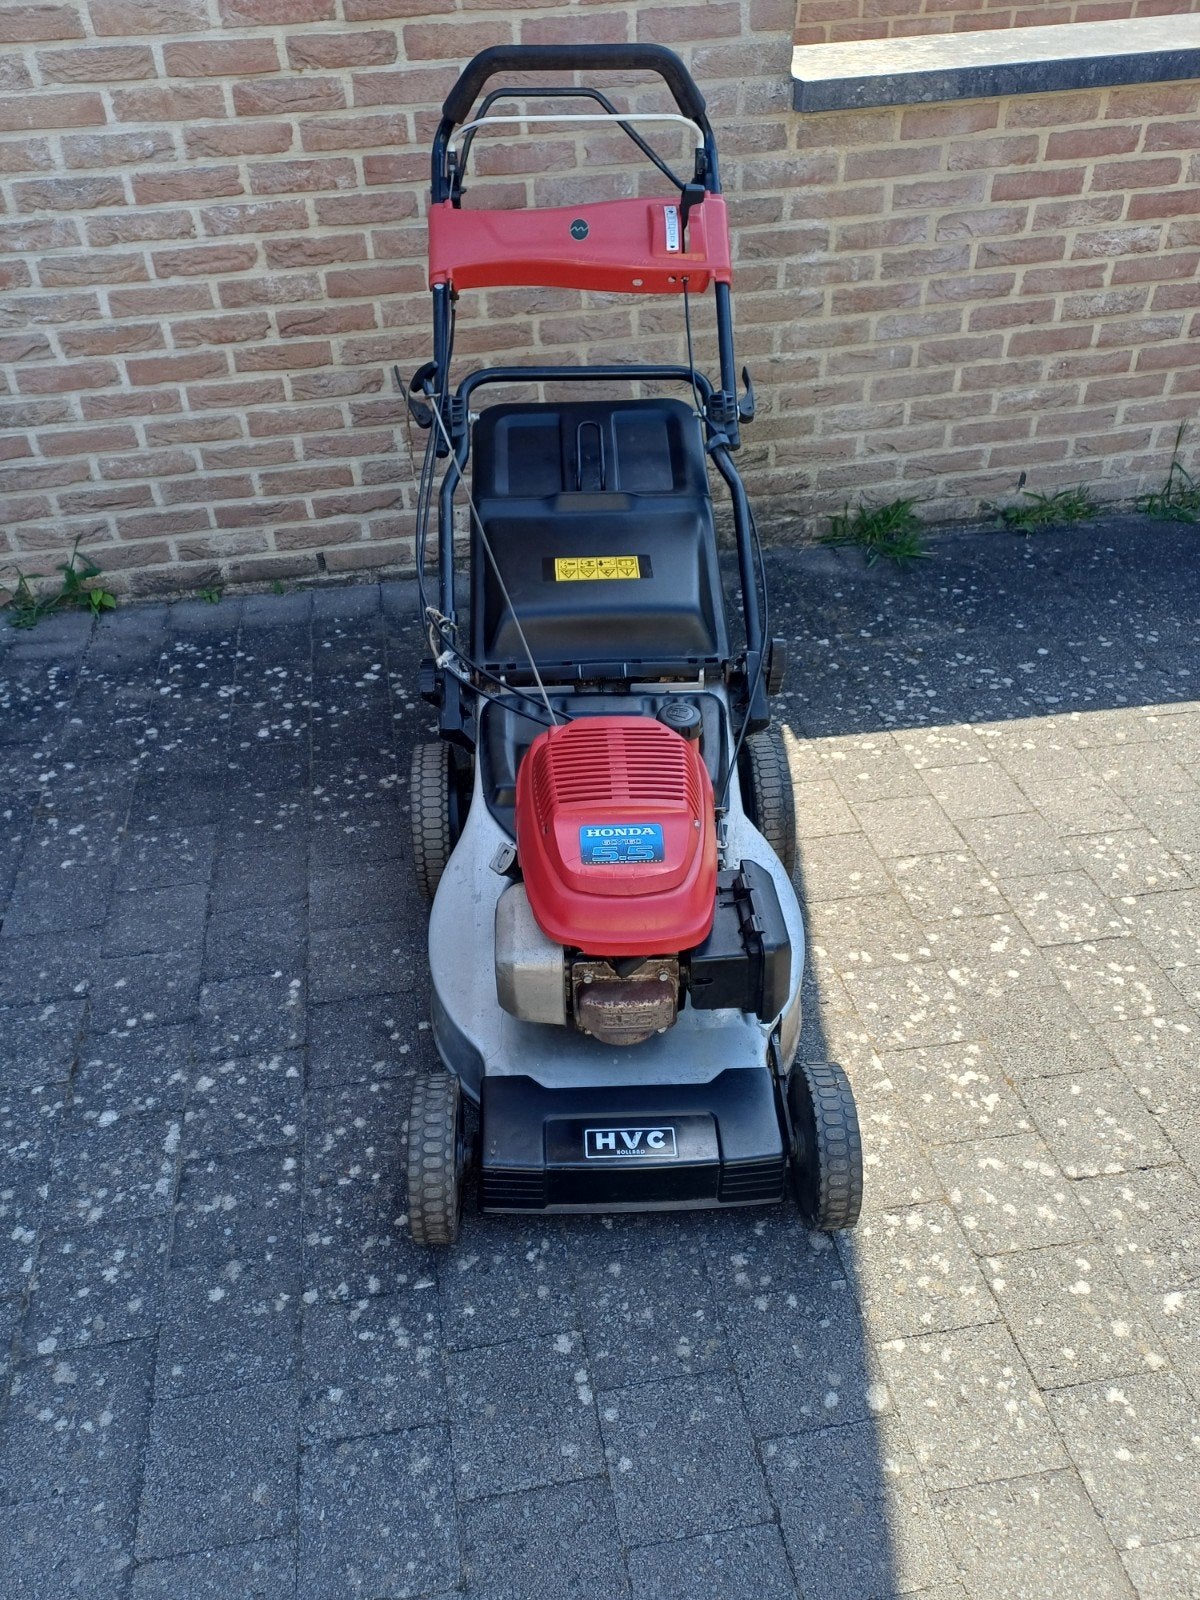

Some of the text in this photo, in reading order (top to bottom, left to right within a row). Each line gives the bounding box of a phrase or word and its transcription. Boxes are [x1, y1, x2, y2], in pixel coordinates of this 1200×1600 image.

[586, 827, 656, 837] HONDA
[592, 845, 655, 862] 5.5
[595, 1130, 666, 1150] HVC
